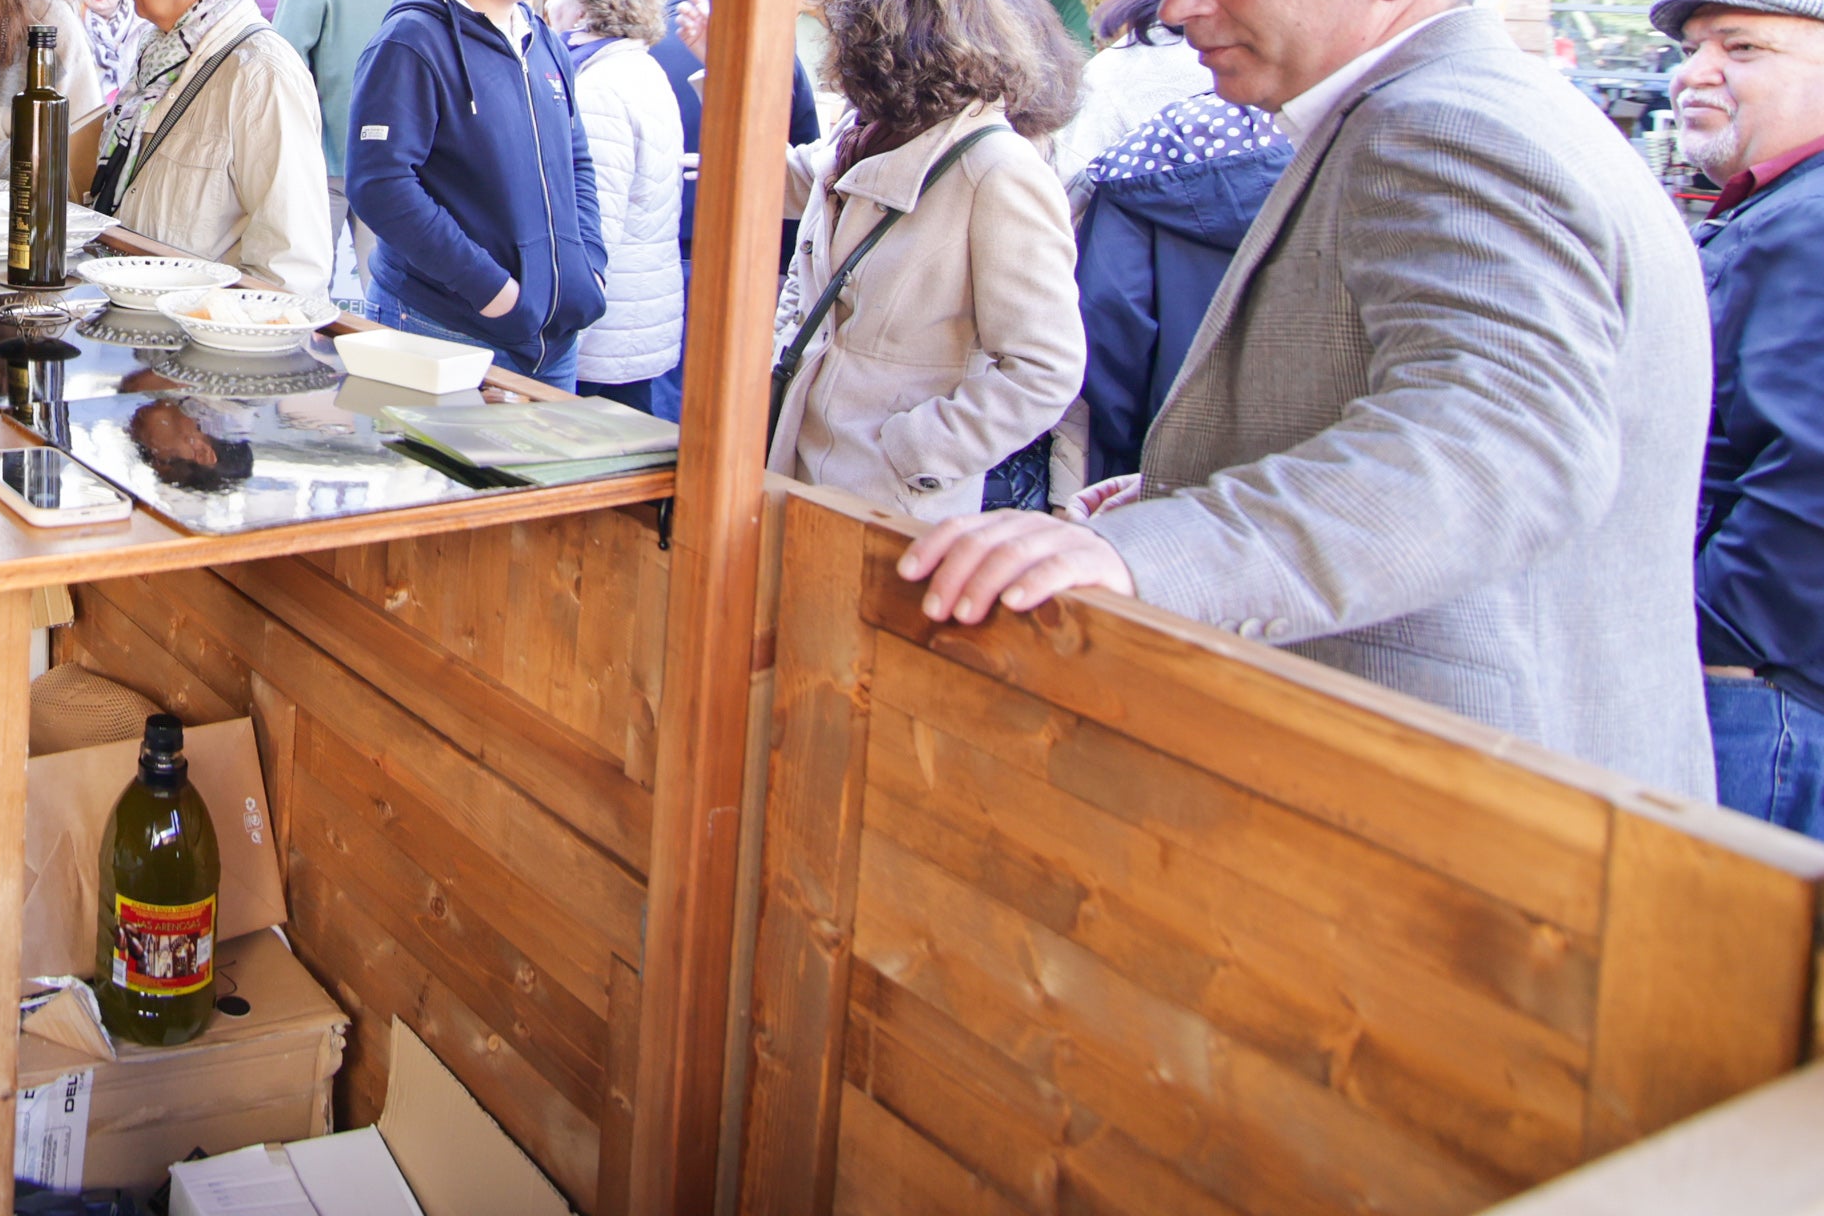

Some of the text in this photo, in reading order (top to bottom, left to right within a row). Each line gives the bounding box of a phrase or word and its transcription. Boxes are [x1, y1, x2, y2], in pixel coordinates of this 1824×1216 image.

[337, 299, 363, 313] CEI
[136, 919, 201, 932] LAS ARENOSAS
[64, 1074, 78, 1113] DEL
